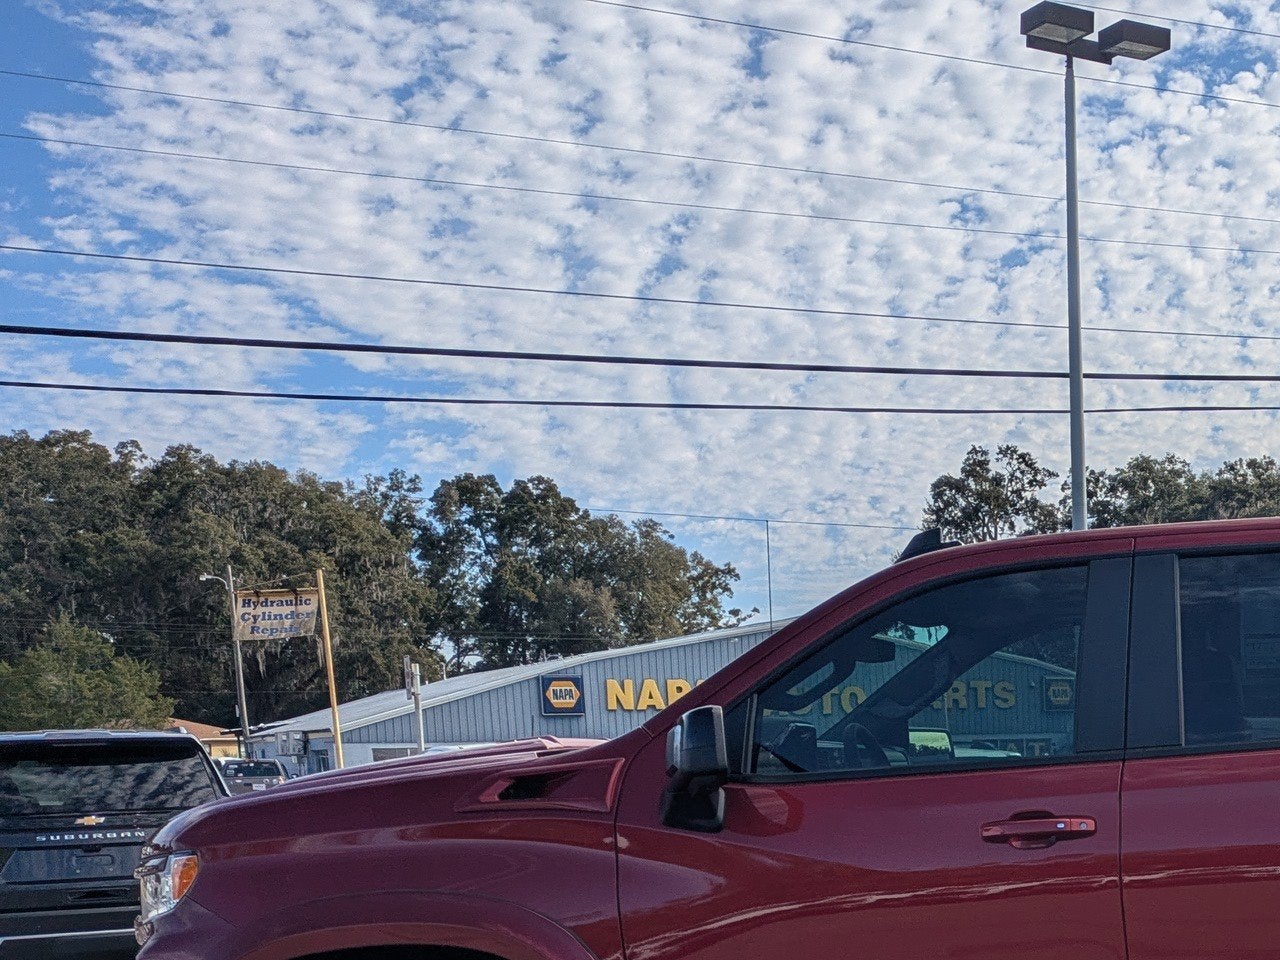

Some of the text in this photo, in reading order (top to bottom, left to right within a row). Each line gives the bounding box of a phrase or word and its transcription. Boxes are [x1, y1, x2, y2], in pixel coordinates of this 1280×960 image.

[241, 596, 311, 610] Hydraulic
[240, 611, 315, 624] Cylinder
[552, 688, 574, 701] NAPA
[605, 678, 704, 711] NAP
[36, 831, 145, 841] SUBURBAN
